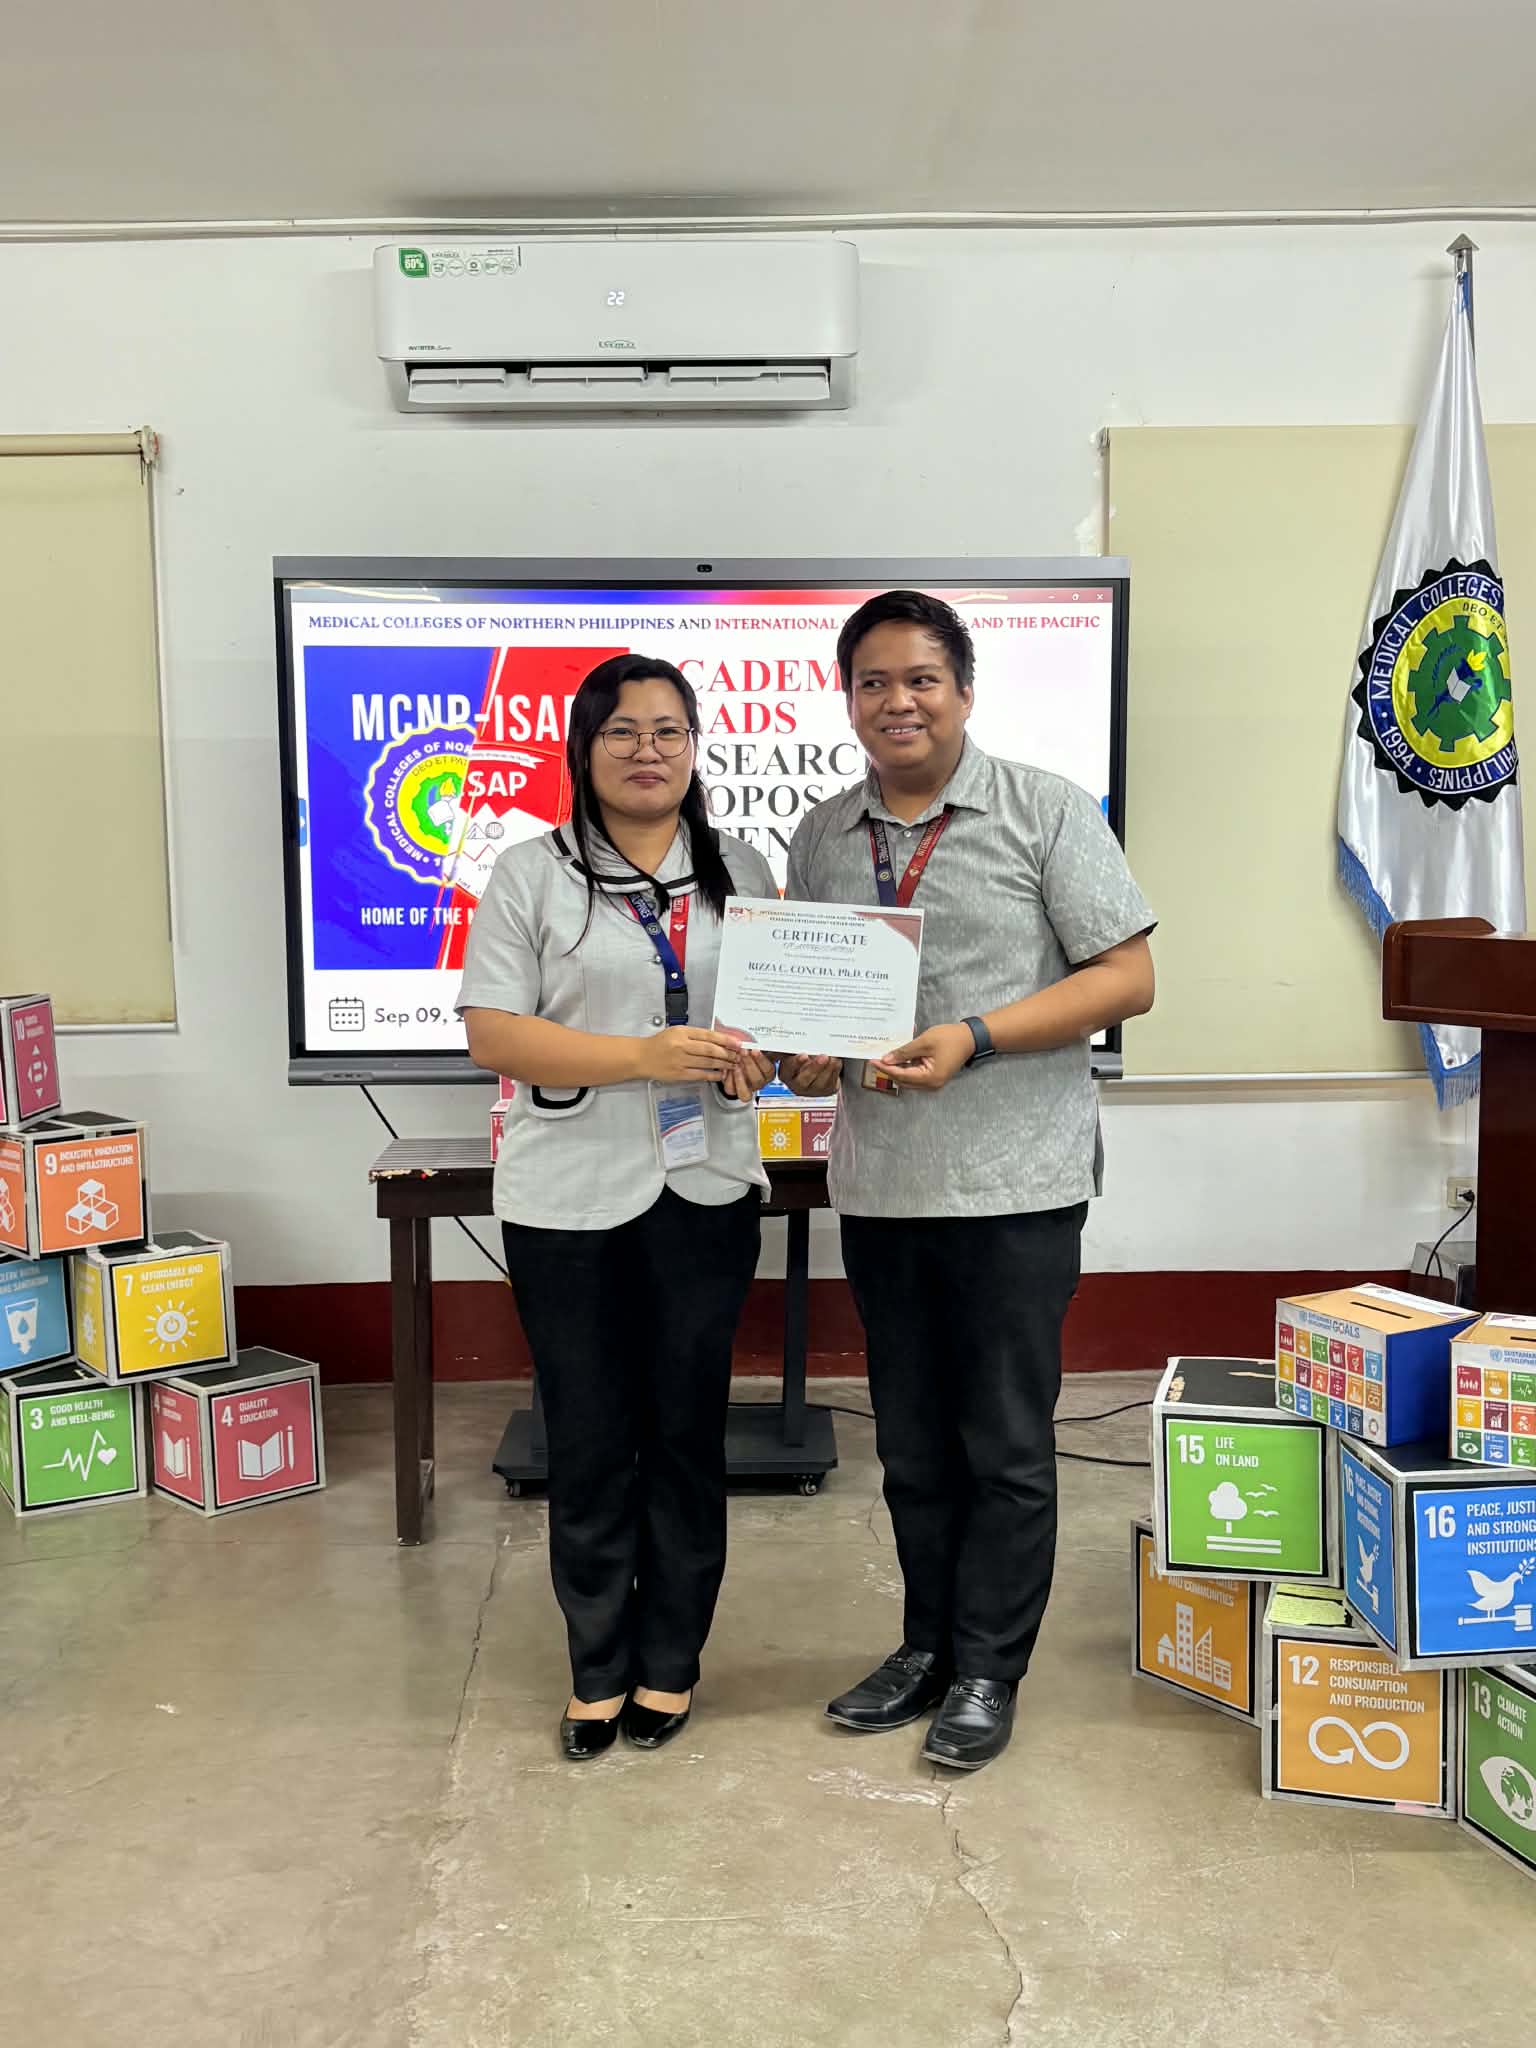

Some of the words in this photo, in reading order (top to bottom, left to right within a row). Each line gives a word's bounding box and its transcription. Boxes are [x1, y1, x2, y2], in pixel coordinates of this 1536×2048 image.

[607, 291, 625, 306] 22
[1462, 601, 1488, 617] DEO
[309, 616, 380, 629] MEDICAL
[383, 617, 463, 629] COLLEGES
[466, 617, 487, 629] OF
[490, 617, 576, 630] NORTHERN
[579, 617, 675, 630] PHILIPPINES
[679, 617, 711, 630] AND
[715, 617, 838, 630] INTERNATIONAL
[971, 616, 1003, 629] AND
[1007, 616, 1038, 629] THE
[1040, 615, 1101, 628] PACIFIC
[1371, 611, 1418, 700] MEDICAL
[1420, 576, 1502, 613] COLLEGES
[1380, 725, 1416, 770] 1994
[699, 743, 866, 776] SEARC
[384, 750, 422, 808] COLLEGES
[423, 743, 441, 754] OF
[465, 770, 528, 798] SAP
[708, 784, 846, 817] OPOS
[385, 812, 423, 862] MEDICAL
[360, 907, 405, 926] HOME
[409, 907, 428, 926] OF
[433, 907, 462, 926] THE
[771, 928, 869, 946] CERTIFICATE
[747, 961, 778, 973] RIZZA
[374, 1007, 410, 1029] Sep
[416, 1007, 447, 1026] 09,
[44, 1153, 58, 1176] 9
[122, 1274, 134, 1297] 7
[1333, 1320, 1361, 1339] GOALS
[50, 1404, 72, 1415] GOOD
[73, 1399, 103, 1411] HEALTH
[239, 1398, 269, 1411] QUALITY
[30, 1408, 44, 1430] 3
[50, 1417, 67, 1427] AND
[69, 1410, 116, 1425] WELL-BEING
[221, 1405, 234, 1427] 4
[239, 1408, 279, 1425] EDUCATION
[1176, 1434, 1206, 1465] 15
[1215, 1436, 1235, 1449] LIFE
[1215, 1454, 1230, 1466] ON
[1232, 1455, 1260, 1468] LAND
[1466, 1502, 1504, 1517] PEACE,
[1506, 1500, 1535, 1515] JUSTI
[1424, 1505, 1456, 1539] 16
[1467, 1522, 1489, 1536] AND
[1493, 1519, 1536, 1535] STRONG
[1288, 1655, 1320, 1686] 12
[1329, 1675, 1408, 1694] CONSUMPTION
[1329, 1694, 1352, 1706] AND
[1354, 1695, 1425, 1713] PRODUCTION
[1472, 1680, 1491, 1719] 13
[1497, 1694, 1527, 1724] CLIMATE
[1497, 1713, 1523, 1741] ACTION
